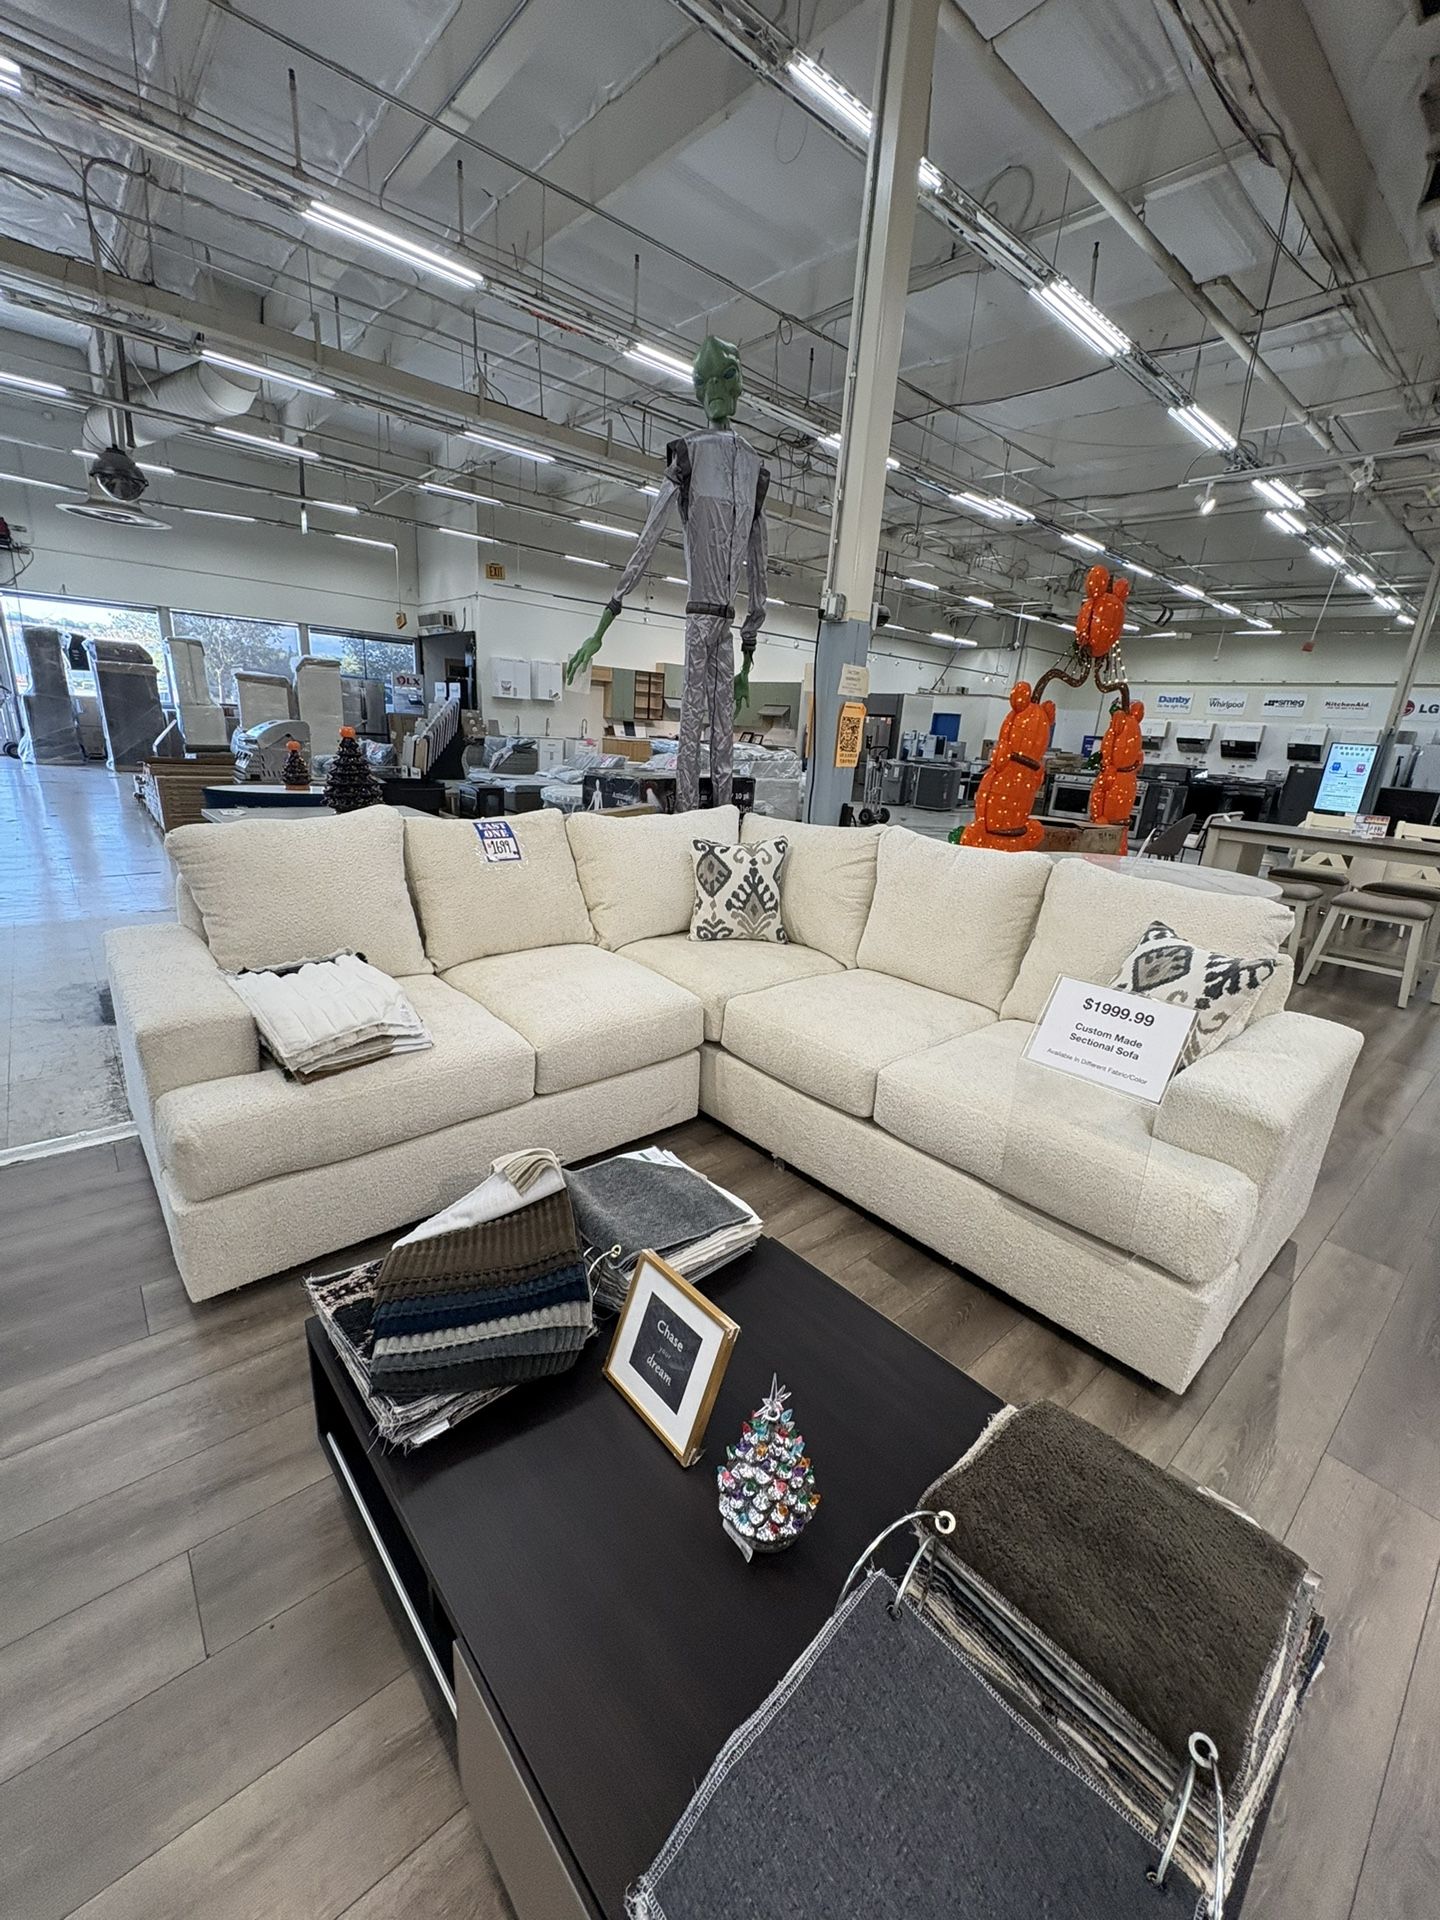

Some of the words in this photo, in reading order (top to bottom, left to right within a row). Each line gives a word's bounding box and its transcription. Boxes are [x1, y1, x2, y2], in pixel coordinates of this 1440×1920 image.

[489, 566, 503, 578] EXIT
[1158, 695, 1191, 705] Danby
[1208, 700, 1245, 710] Whirlpool
[1279, 699, 1305, 708] smeg
[1418, 703, 1440, 714] LG
[476, 822, 507, 830] LAST
[484, 829, 510, 838] ONE
[1083, 998, 1155, 1027] $1999.99
[1075, 1022, 1113, 1040] Custom
[1114, 1034, 1143, 1049] Made
[1069, 1032, 1114, 1053] Sectional
[1115, 1046, 1140, 1061] Sofa
[1047, 1048, 1073, 1061] Available
[1074, 1055, 1080, 1063] In
[1080, 1057, 1107, 1072] Different
[1108, 1065, 1148, 1085] Fabric/Color
[657, 1320, 684, 1352] Chase
[659, 1346, 672, 1360] your
[647, 1353, 672, 1386] dream
